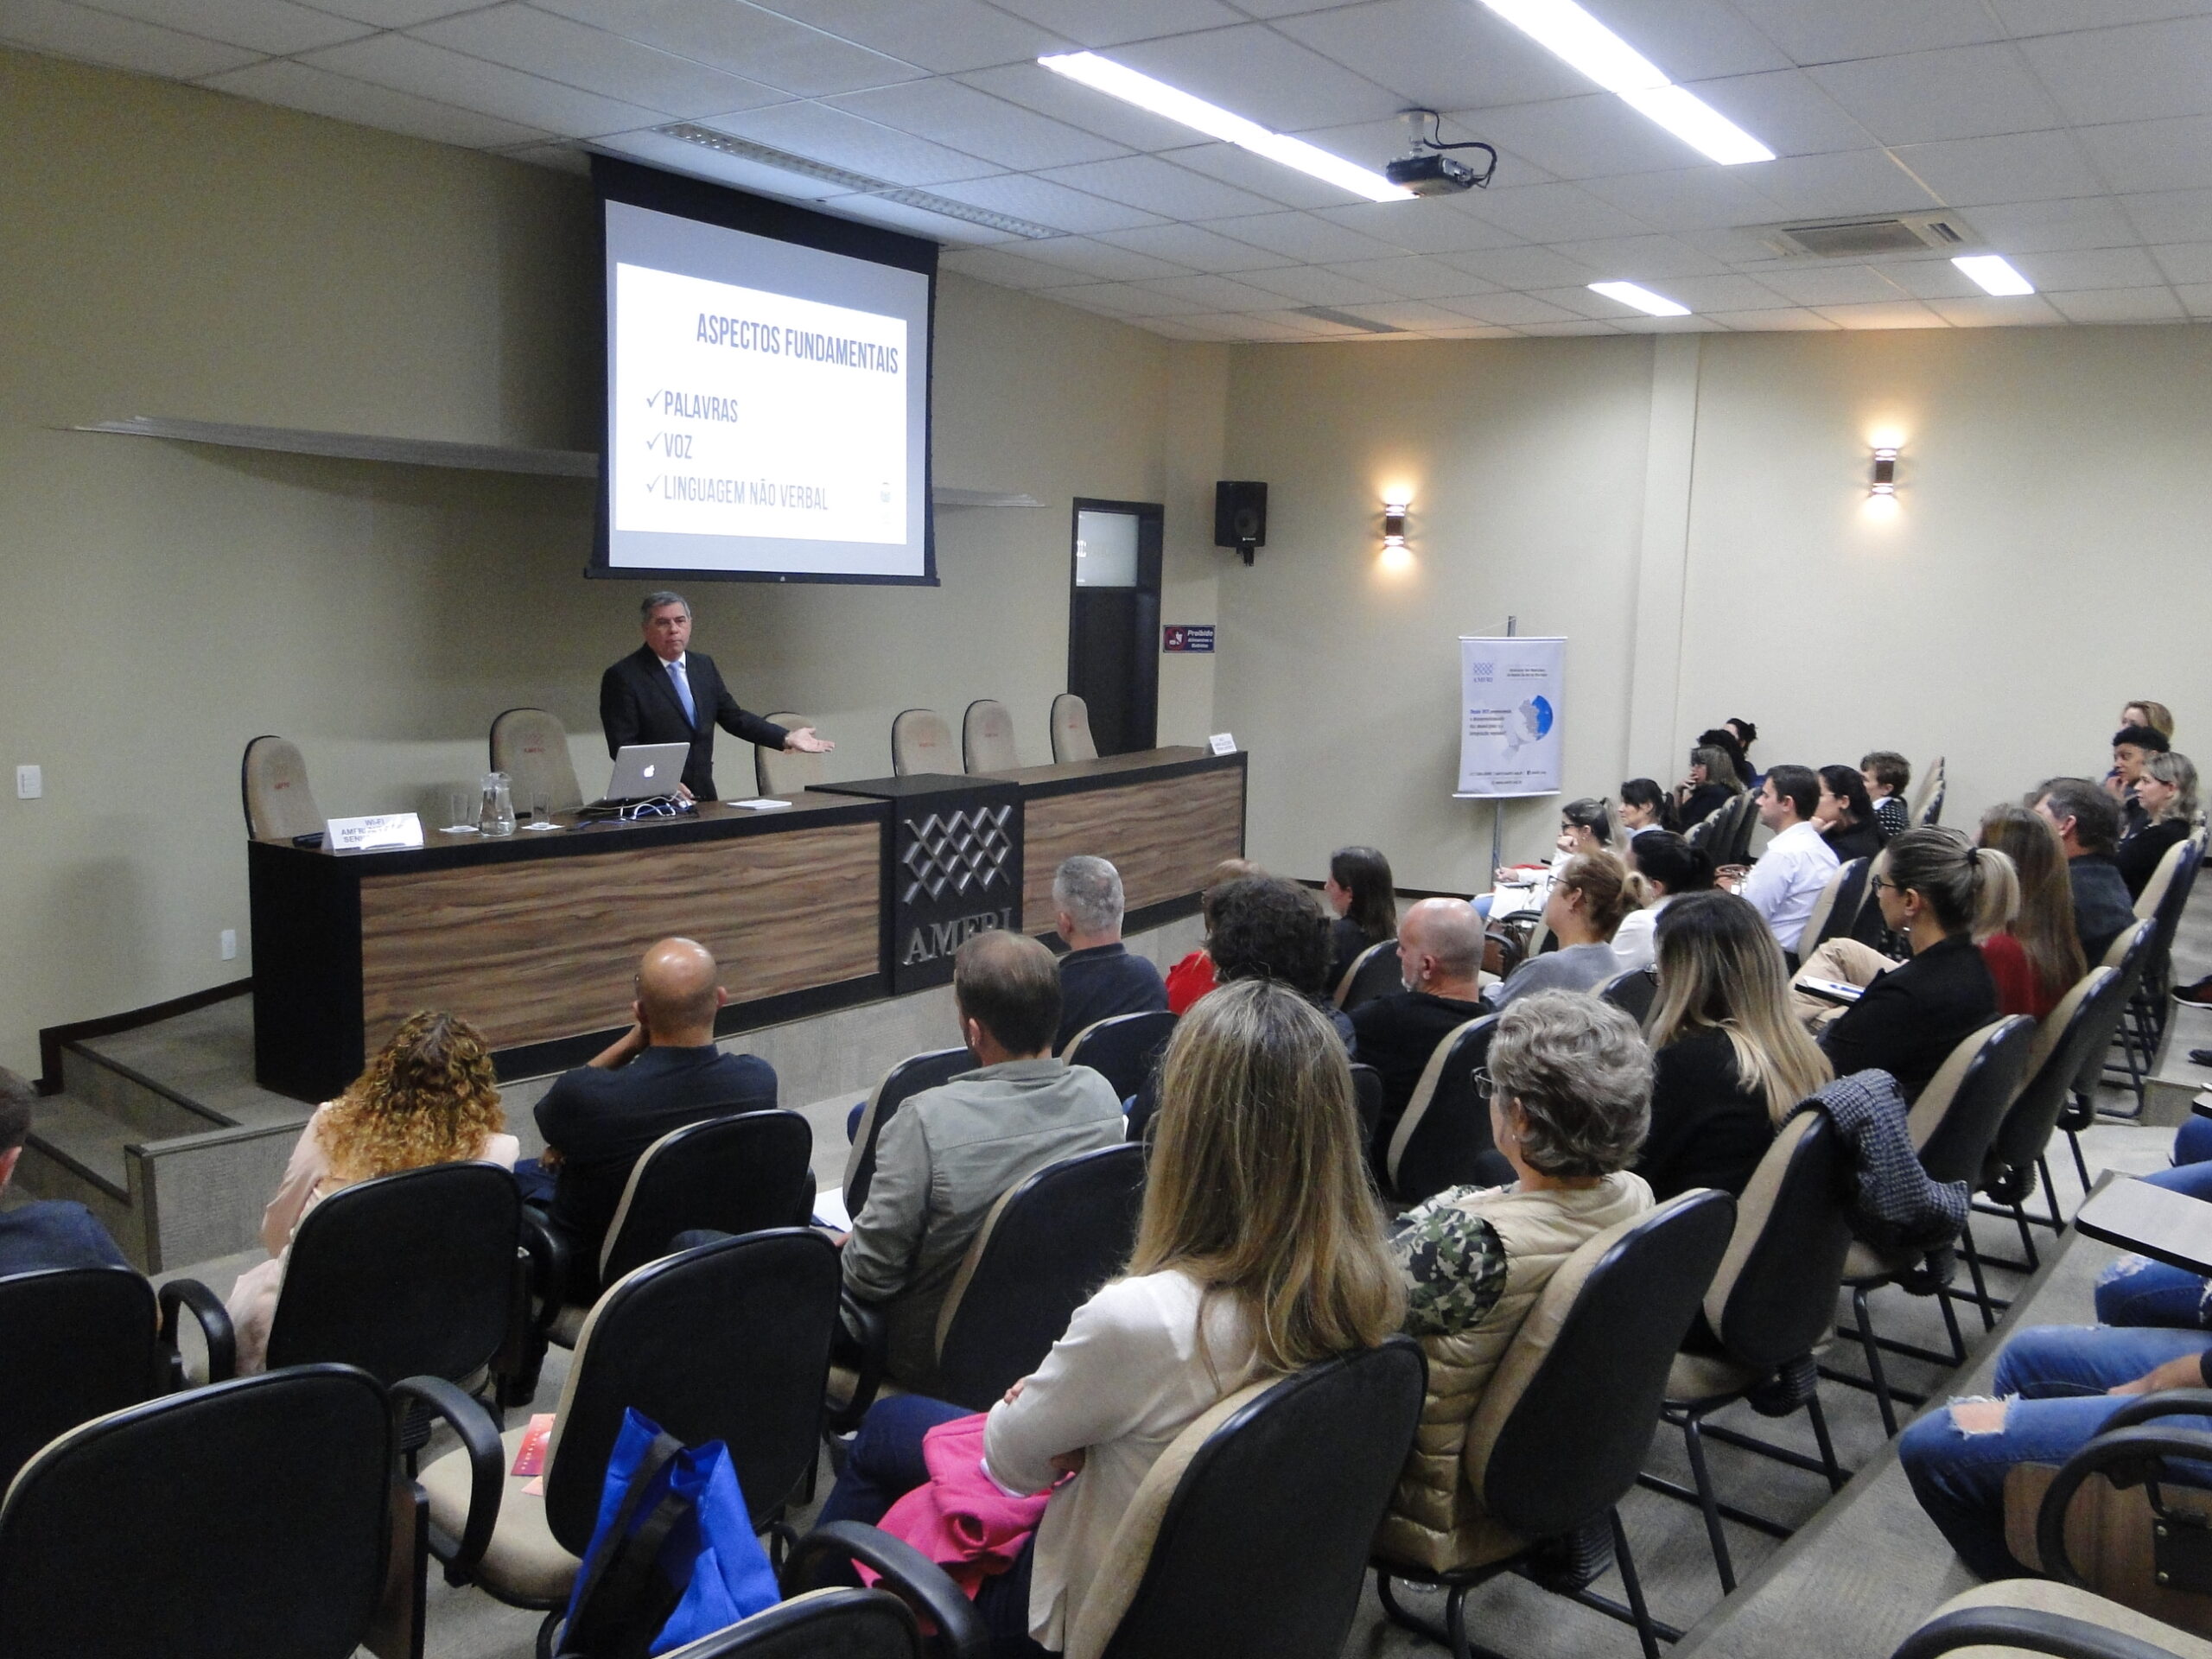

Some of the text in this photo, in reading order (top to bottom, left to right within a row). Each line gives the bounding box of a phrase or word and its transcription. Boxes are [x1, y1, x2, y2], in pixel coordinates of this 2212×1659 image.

[696, 313, 899, 374] ASPECTOS FUNDAMENTAIS
[664, 391, 739, 423] PALAVRAS
[664, 433, 693, 460] VOZ
[664, 474, 829, 511] LINGUAGEM NÃO VERBAL
